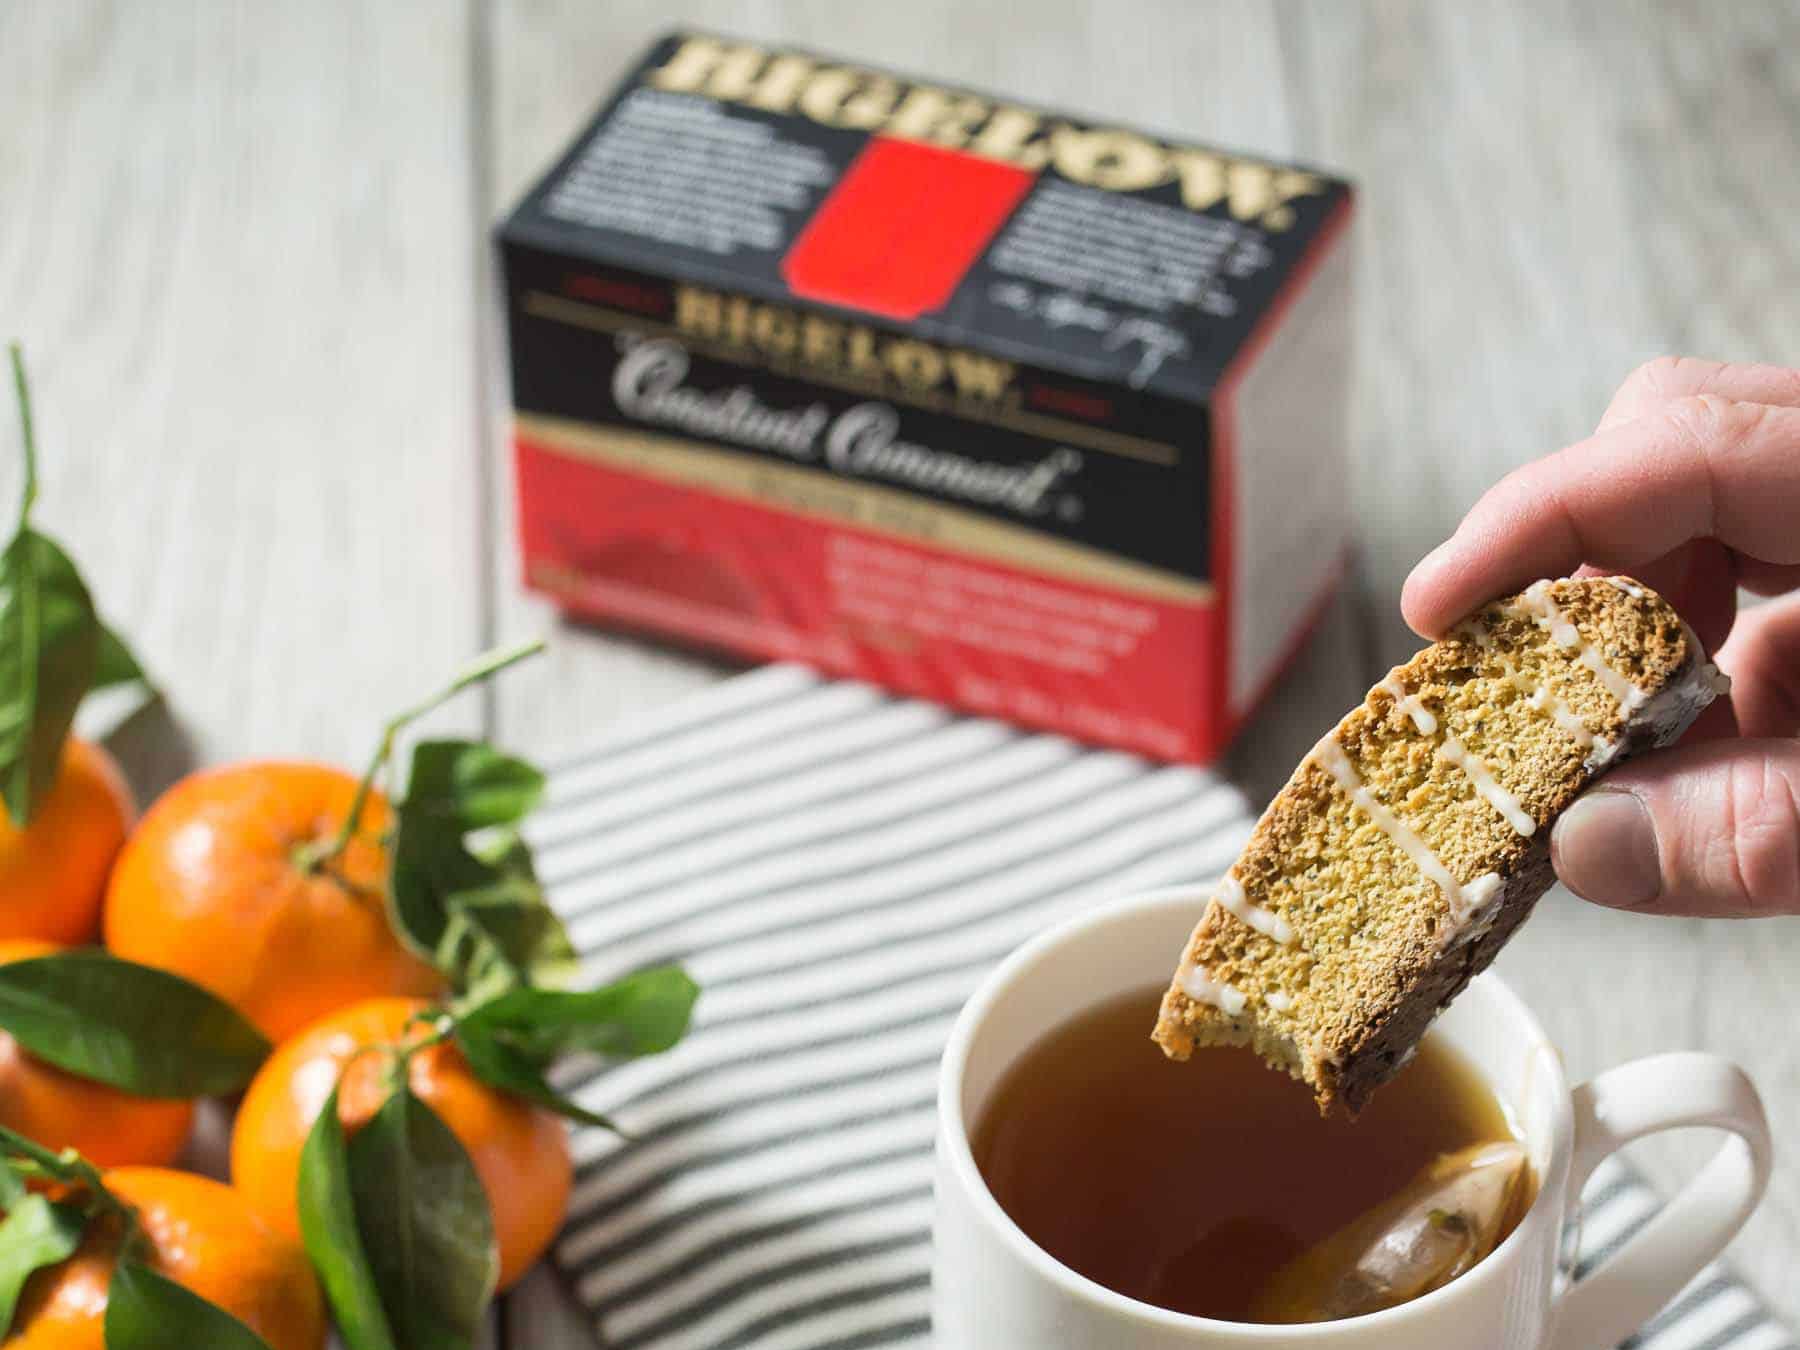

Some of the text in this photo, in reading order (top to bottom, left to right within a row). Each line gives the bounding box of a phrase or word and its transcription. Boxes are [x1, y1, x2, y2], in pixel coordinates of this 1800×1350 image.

[673, 282, 1016, 402] BIGELOW
[612, 332, 829, 460] Constant
[826, 401, 1083, 516] Comment
